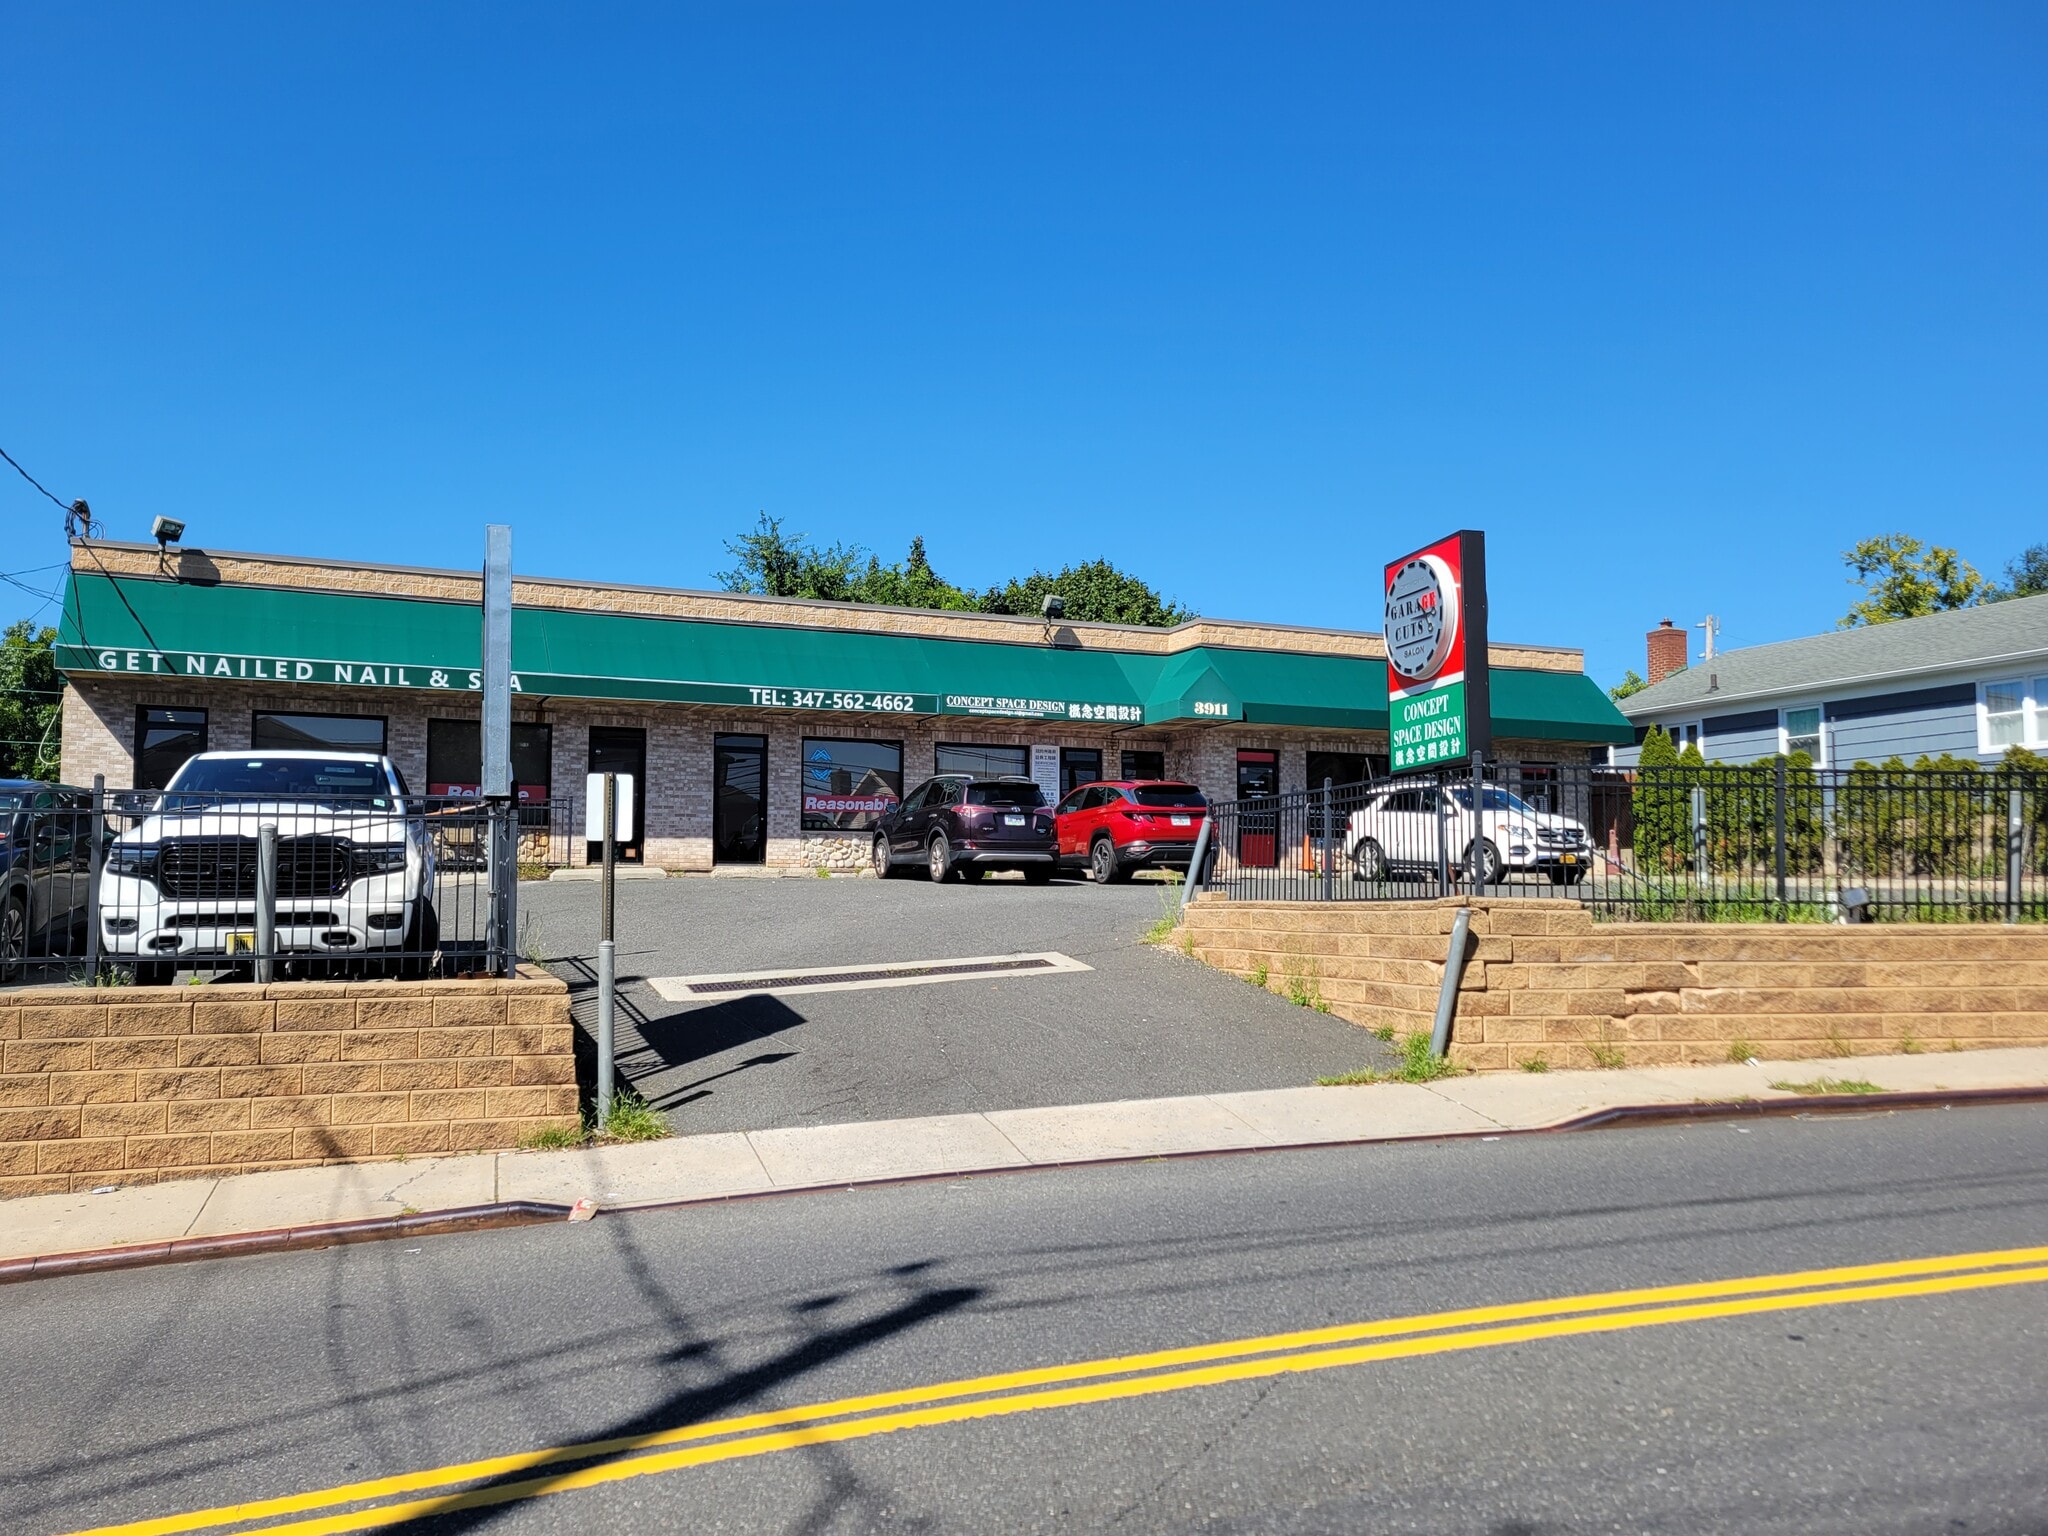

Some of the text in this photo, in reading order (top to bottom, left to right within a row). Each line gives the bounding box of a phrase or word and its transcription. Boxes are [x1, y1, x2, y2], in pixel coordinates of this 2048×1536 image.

[1391, 591, 1436, 620] GARAGE
[1395, 620, 1424, 642] CUTS
[1404, 645, 1425, 658] SALON
[99, 651, 522, 692] GET NAILED NAIL & SA
[749, 688, 914, 711] TEL: 347-562-4662
[946, 695, 1066, 712] CONCEPT SPACE DESIGN
[1194, 702, 1228, 716] 3911
[1403, 694, 1449, 722] CONCEPT
[1393, 715, 1461, 747] SPACE DESIGN
[805, 796, 896, 811] Reasonabl
